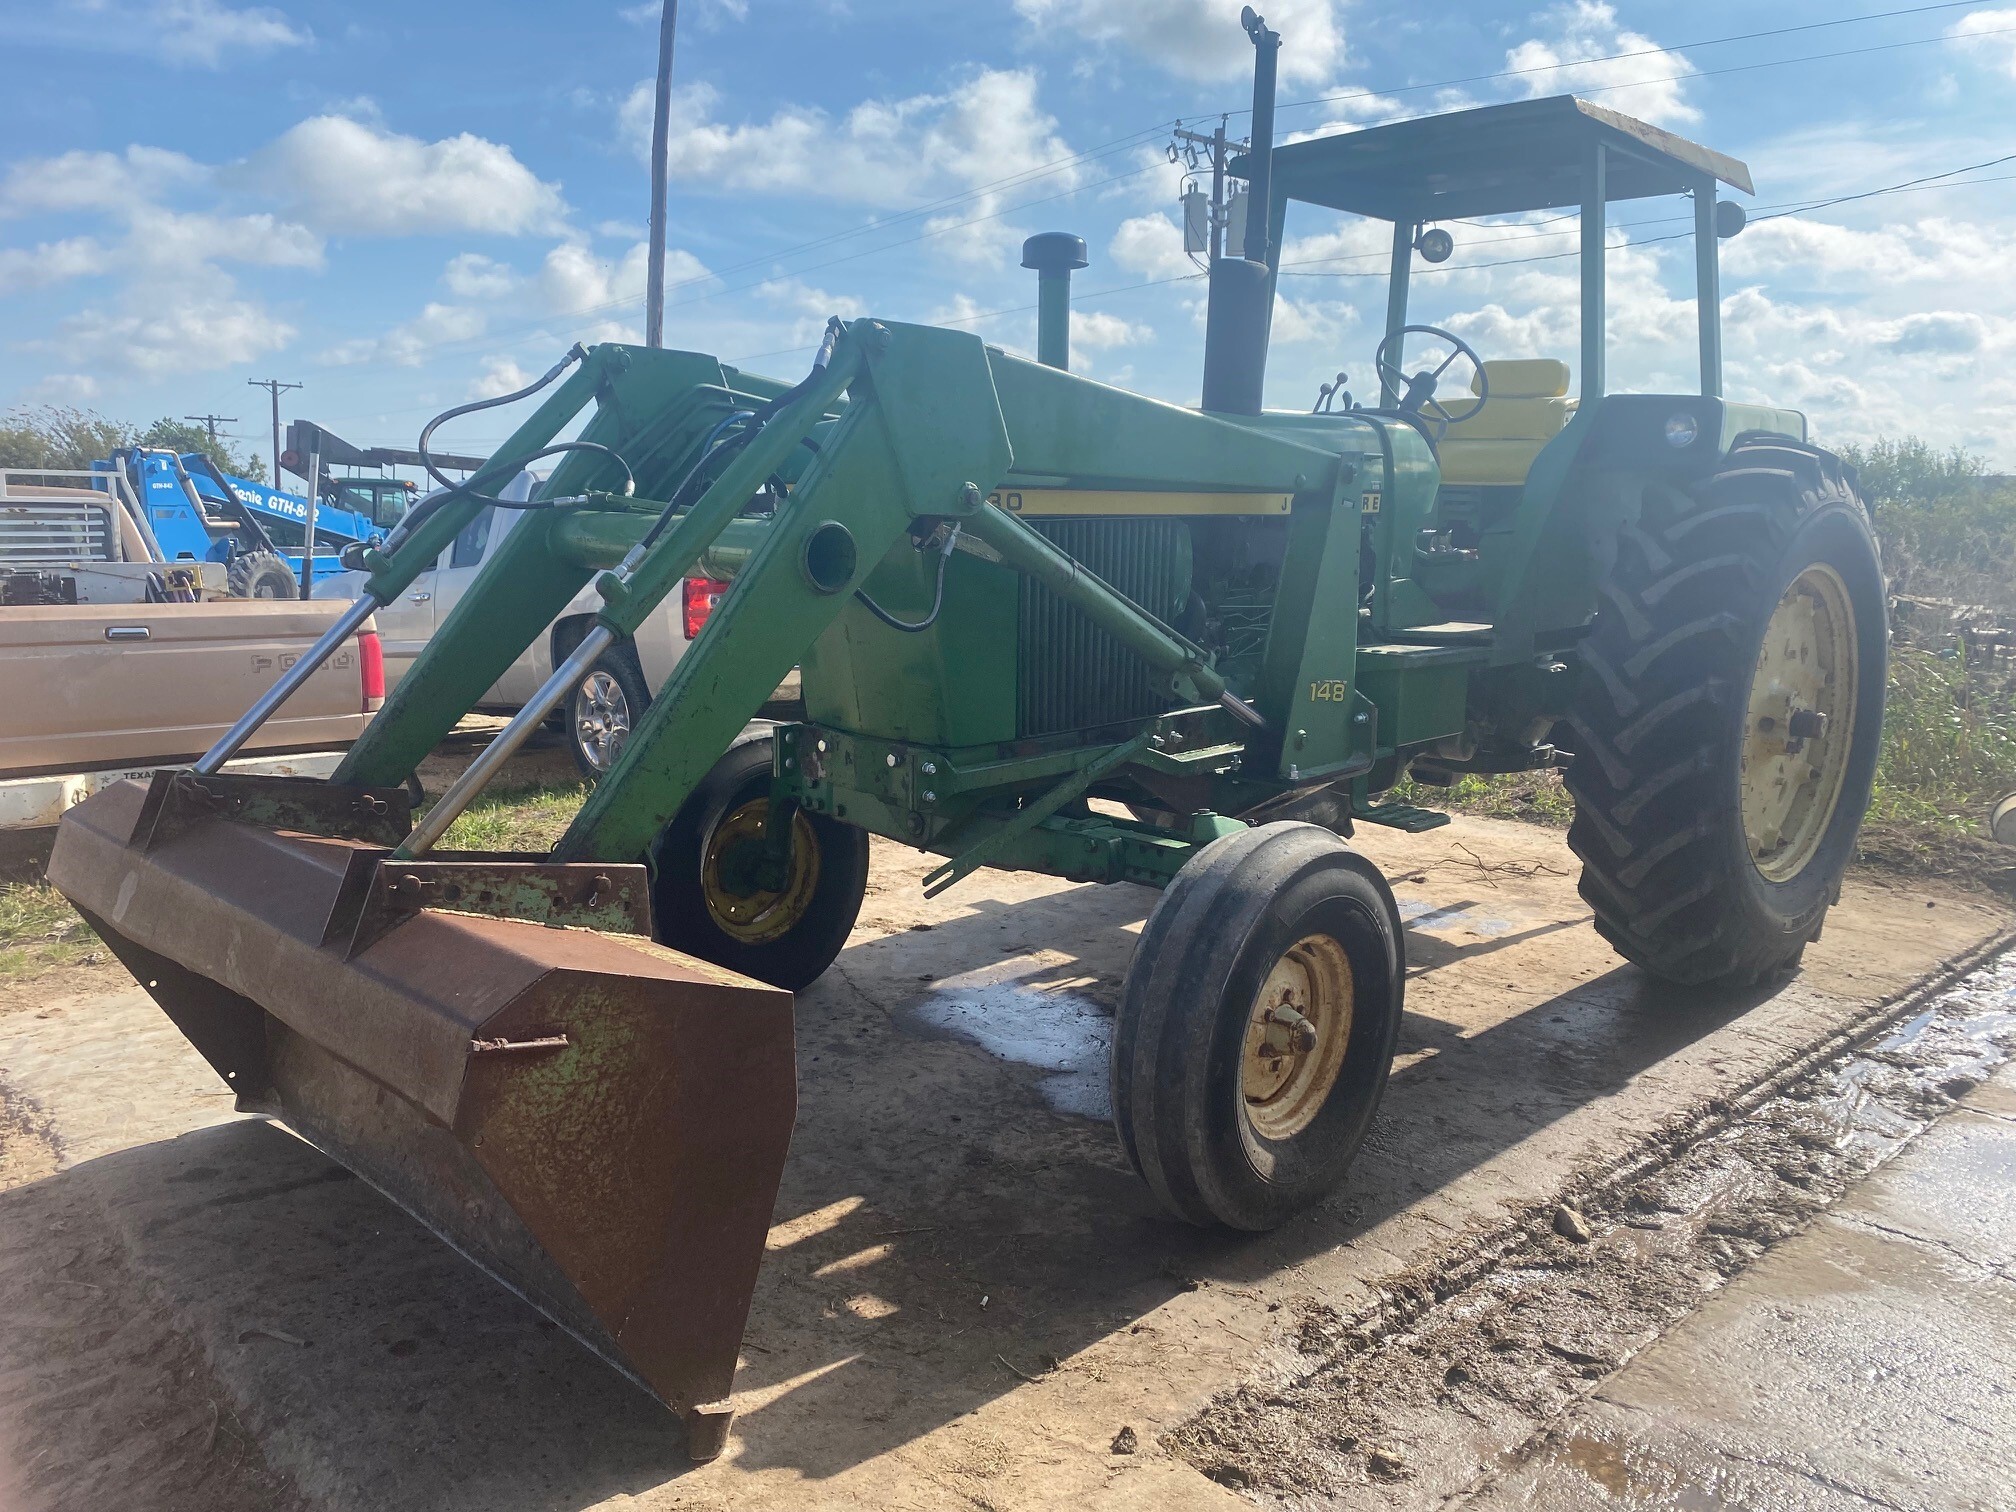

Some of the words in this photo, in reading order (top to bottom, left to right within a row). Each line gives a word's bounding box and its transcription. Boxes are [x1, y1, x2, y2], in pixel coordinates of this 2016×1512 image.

[268, 496, 319, 522] GTH-82
[251, 652, 354, 674] FOD
[1309, 681, 1346, 703] 148
